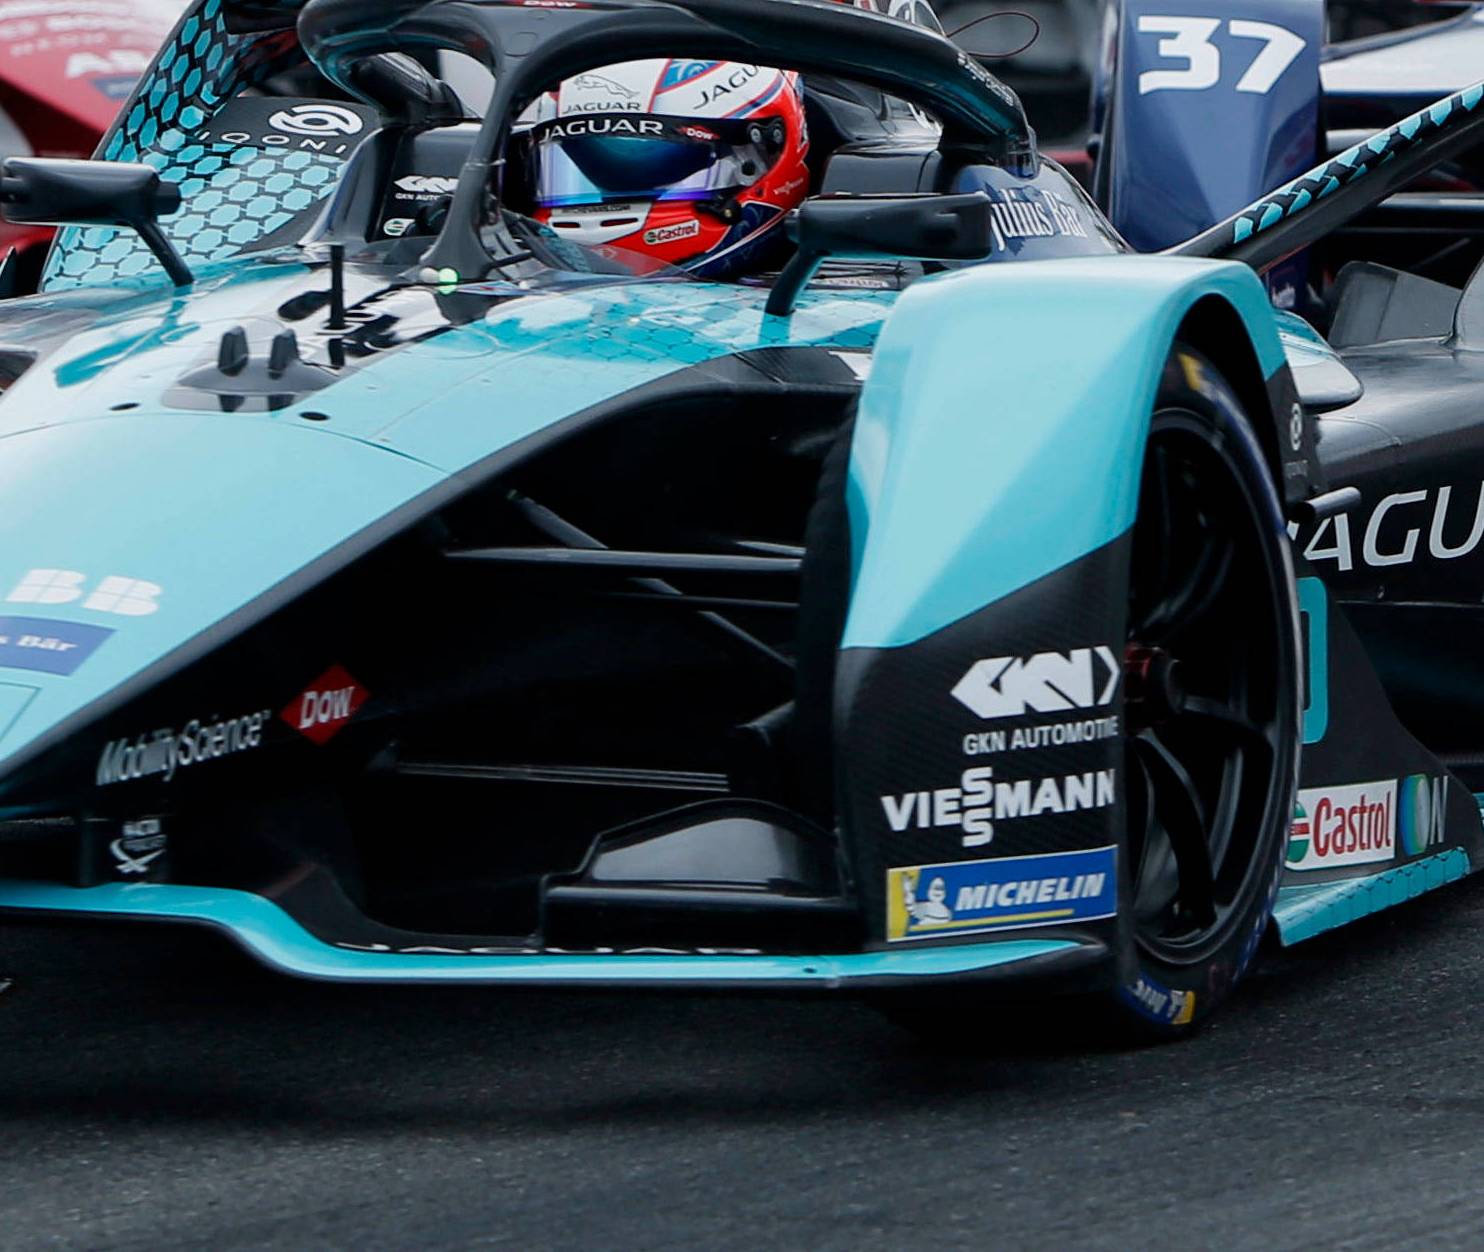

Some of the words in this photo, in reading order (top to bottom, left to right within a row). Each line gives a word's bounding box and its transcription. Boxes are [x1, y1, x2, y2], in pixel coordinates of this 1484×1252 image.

[1138, 15, 1307, 95] 37
[562, 100, 642, 114] JAGUAR
[692, 63, 759, 110] JAGU
[538, 118, 664, 143] JAGUAR
[656, 222, 698, 242] Castrol
[298, 686, 356, 729] DOW
[963, 728, 1007, 756] GKN
[1312, 791, 1392, 858] Castrol
[954, 872, 1106, 917] MICHELIN
